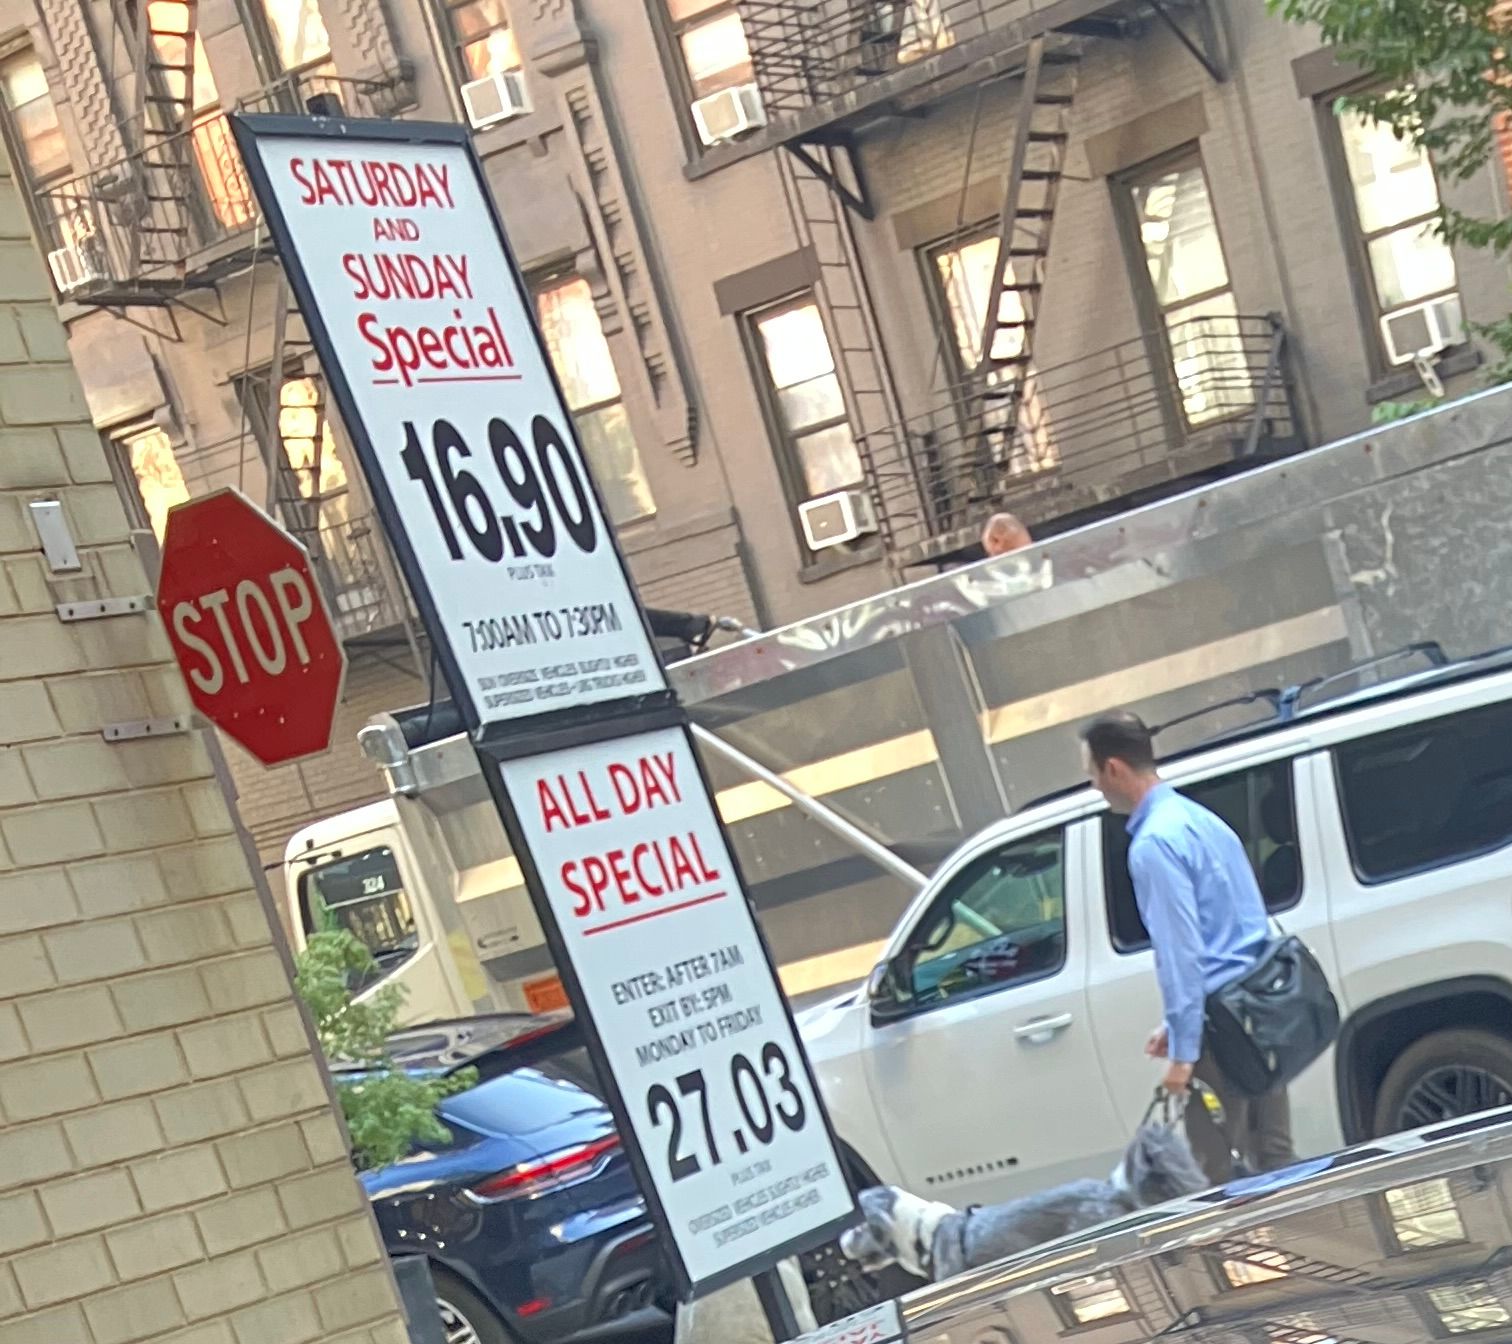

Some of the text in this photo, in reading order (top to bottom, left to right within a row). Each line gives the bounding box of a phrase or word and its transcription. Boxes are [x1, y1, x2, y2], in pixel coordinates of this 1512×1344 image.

[289, 158, 456, 208] SATURDAY
[372, 217, 420, 242] AND
[342, 254, 474, 301] SUNDAY
[358, 308, 514, 388] Special
[399, 413, 597, 563] 16.90
[173, 567, 313, 695] STOP
[462, 602, 623, 653] 7:00AM TO 7:30PM
[536, 752, 683, 833] ALL DAY
[560, 832, 720, 918] SPECIAL
[611, 944, 745, 1005] ENTER: AFTER 7AM
[648, 1000, 680, 1028] EXIT
[701, 983, 733, 1010] 5PM
[635, 1004, 763, 1068] MONDAY TO FRIDAY
[646, 1040, 807, 1183] 27.03
